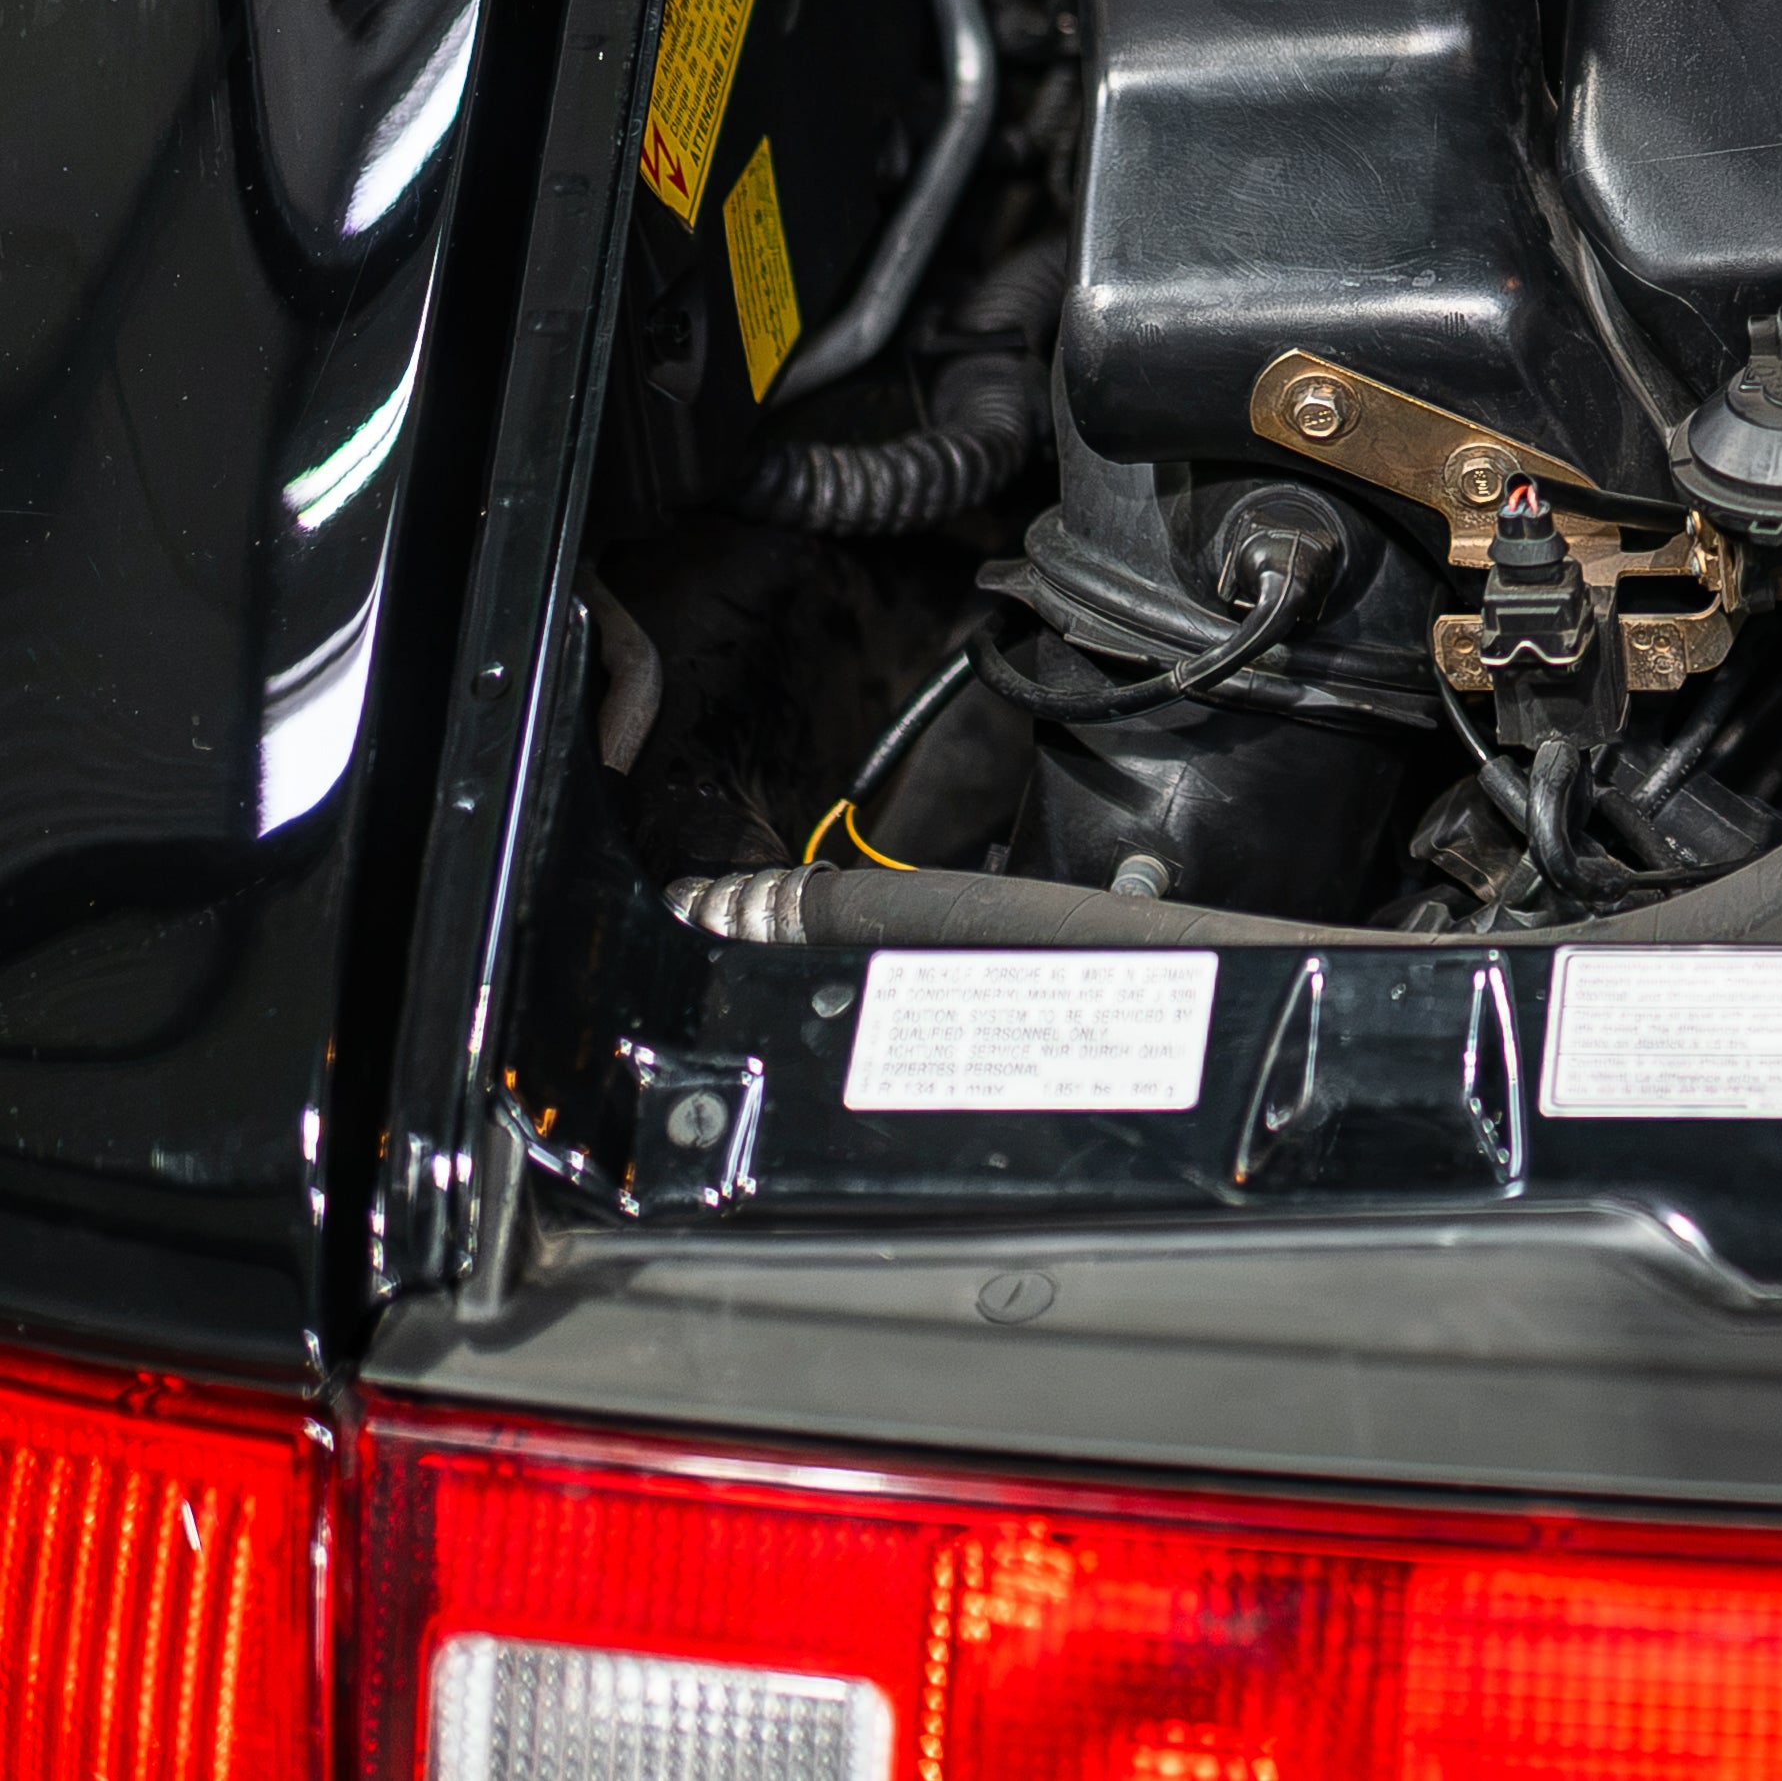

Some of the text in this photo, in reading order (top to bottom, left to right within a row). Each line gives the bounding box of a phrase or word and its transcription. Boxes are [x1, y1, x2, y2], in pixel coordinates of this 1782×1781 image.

[661, 63, 682, 126] Electric
[690, 57, 724, 167] ATTENZIONE
[718, 12, 736, 60] ALTA
[670, 80, 691, 140] Danger
[983, 967, 1041, 984] PORSCHE
[874, 989, 897, 1003] AIR
[969, 1009, 1028, 1024] SYSTEM
[1065, 1009, 1083, 1024] BE
[1093, 1009, 1164, 1024] SERVICED
[888, 1027, 964, 1042] QUALIFIED
[972, 1027, 1059, 1042] PERSONNEL
[968, 1045, 1031, 1059] SERVICE
[1041, 1045, 1069, 1059] NUR
[1078, 1045, 1129, 1059] DURCH
[881, 1062, 1040, 1077] FIZIERTES PERSONAL
